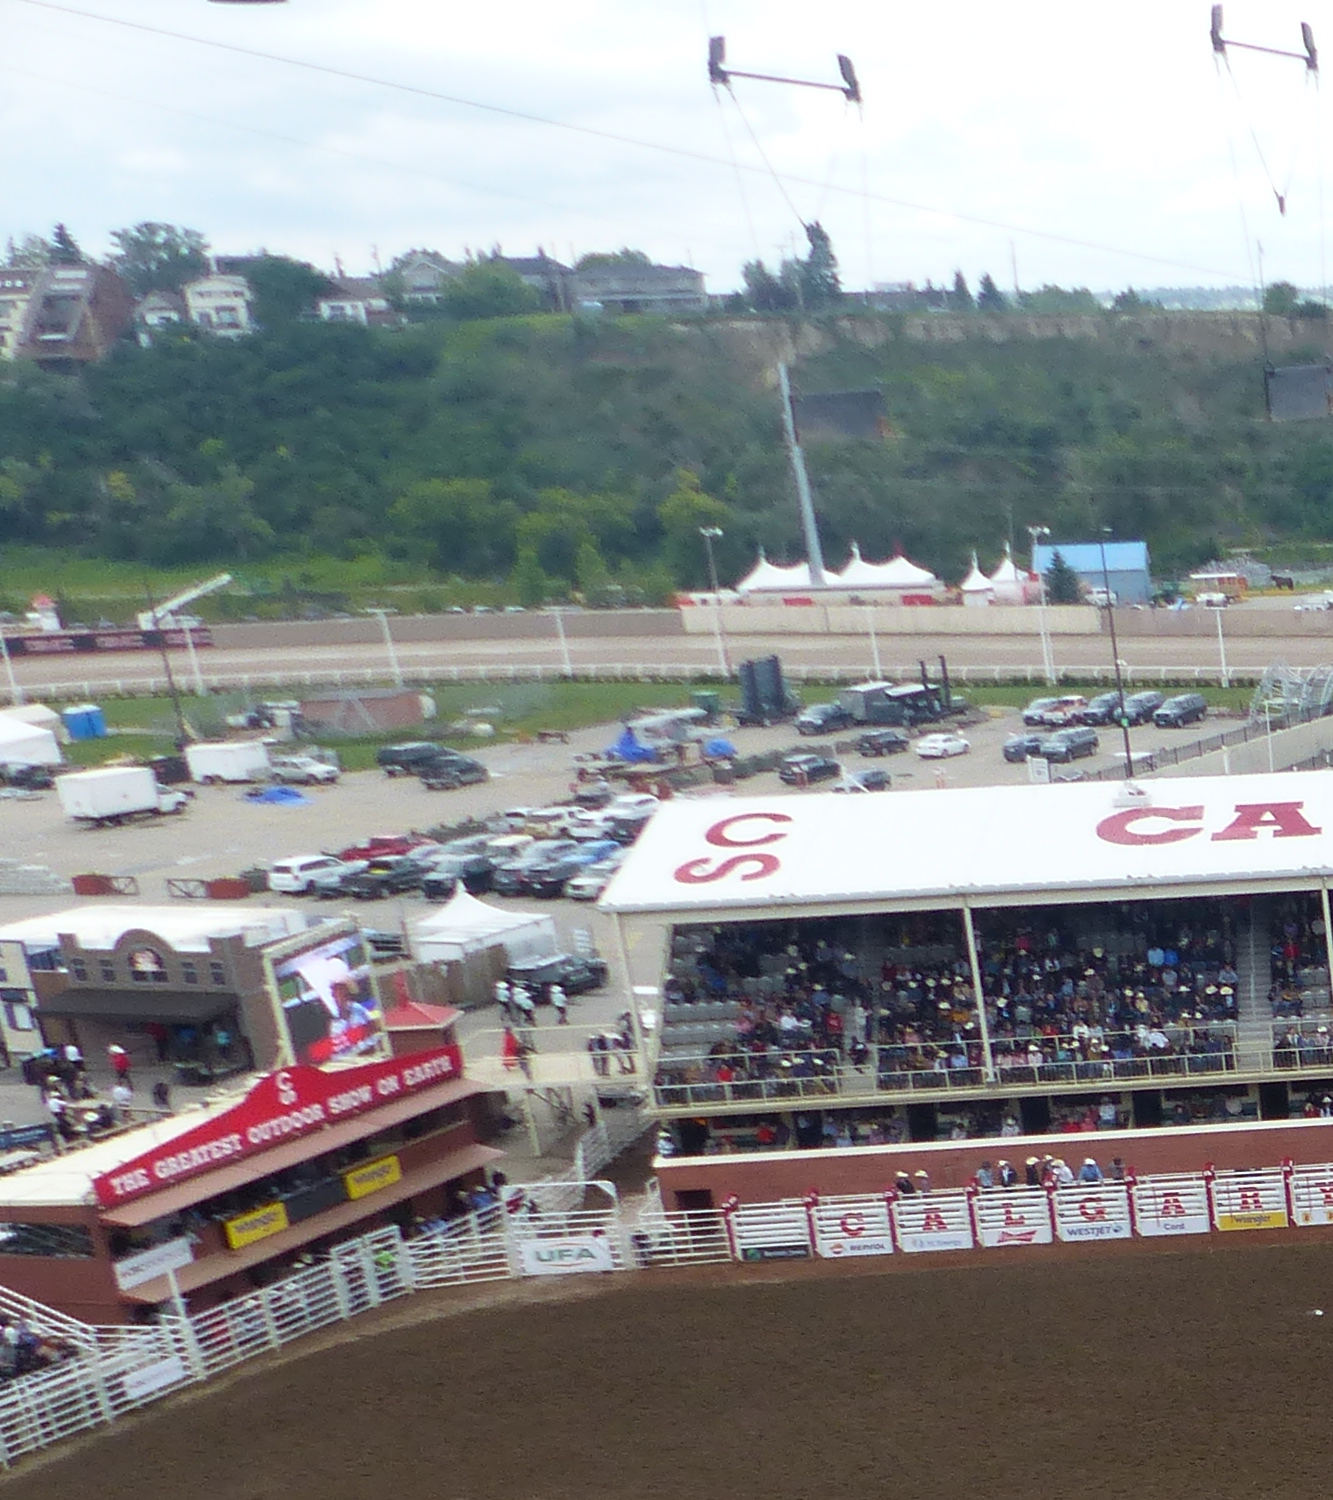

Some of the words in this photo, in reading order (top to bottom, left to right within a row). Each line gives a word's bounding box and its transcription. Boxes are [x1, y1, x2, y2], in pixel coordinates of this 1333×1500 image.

[110, 1170, 149, 1195] THE
[154, 1134, 243, 1179] GREATEST
[246, 1104, 324, 1143] OUTDOOR
[328, 1085, 372, 1115] SHOW
[377, 1076, 399, 1095] ON
[402, 1055, 452, 1086] EARTH
[1066, 1226, 1111, 1237] WESTJET
[535, 1247, 596, 1262] UFA
